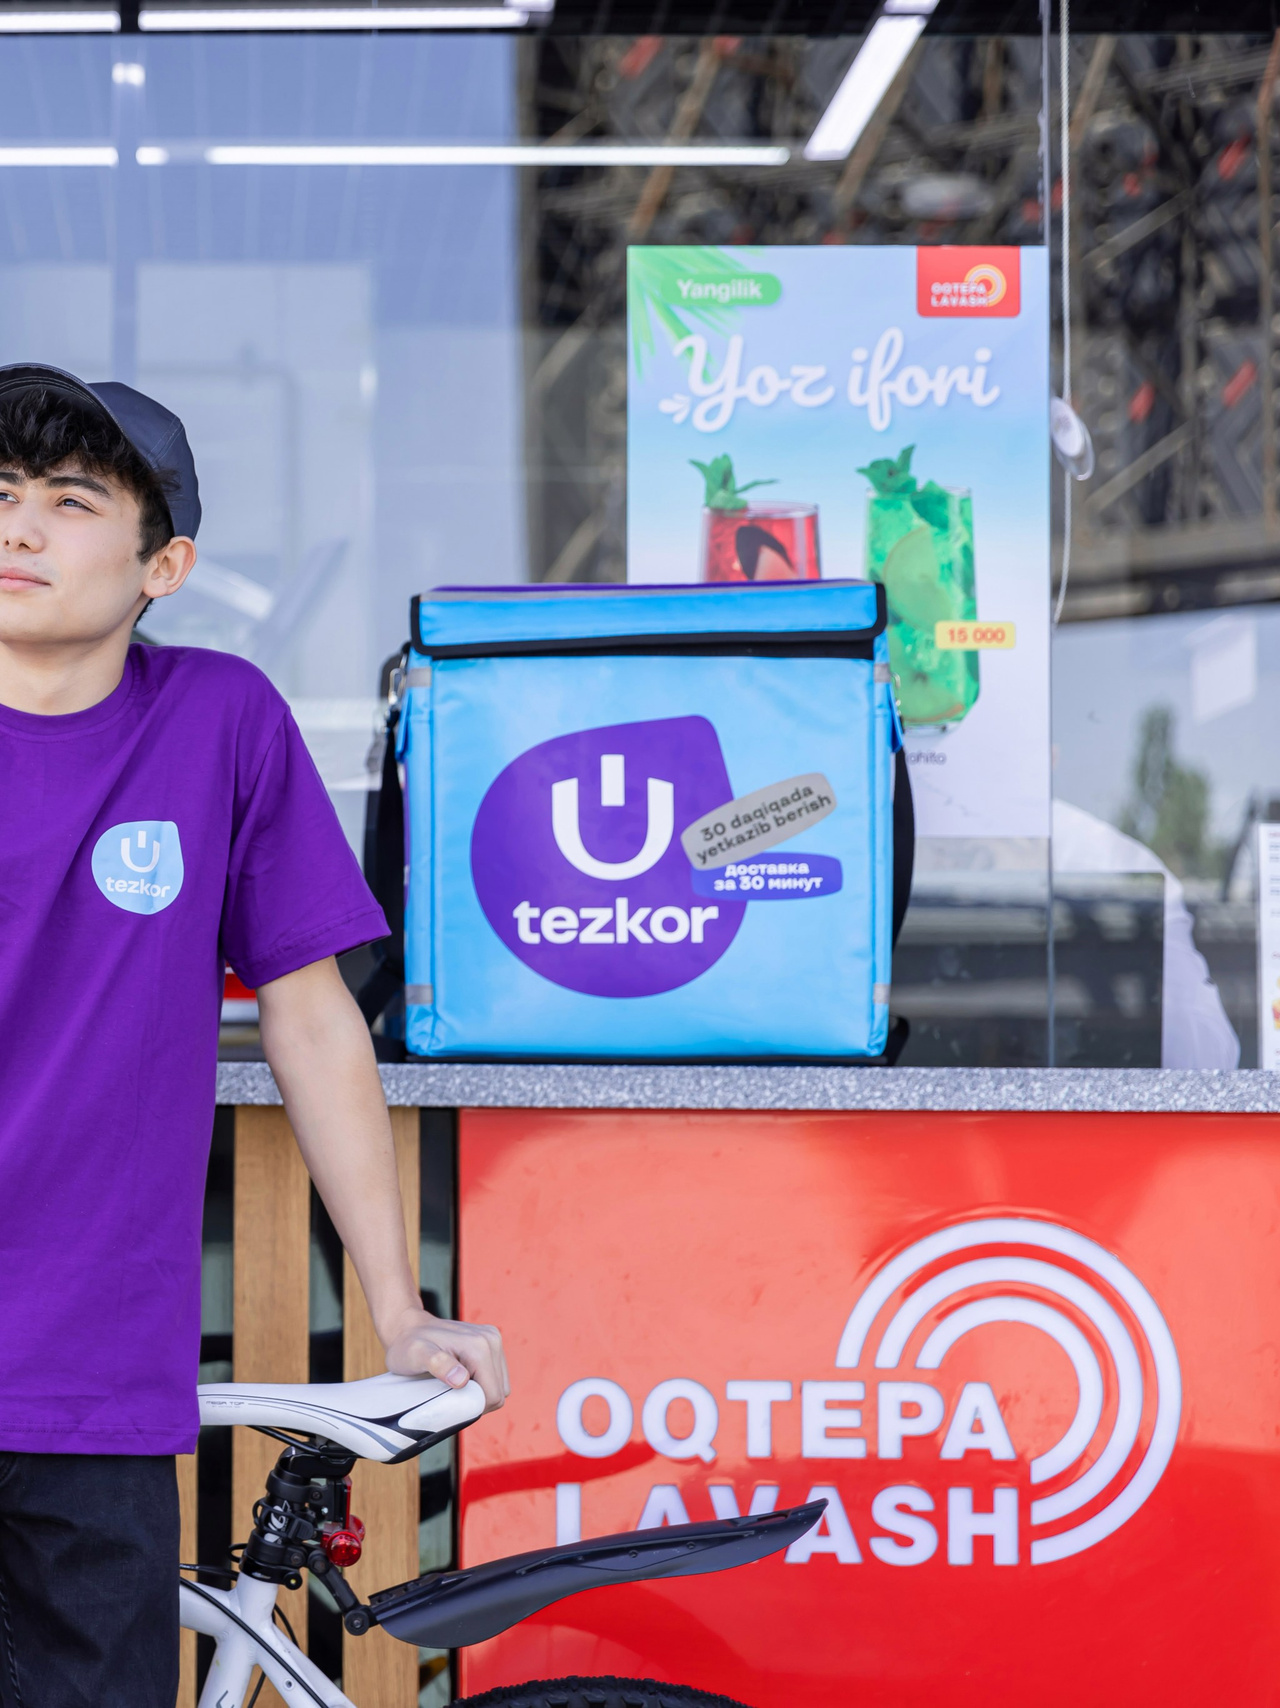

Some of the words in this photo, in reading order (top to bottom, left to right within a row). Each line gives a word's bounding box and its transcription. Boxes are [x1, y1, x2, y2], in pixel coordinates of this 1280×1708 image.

[677, 278, 763, 304] Yangilik
[930, 295, 988, 307] LAVASH
[672, 334, 835, 431] Yoz
[847, 327, 1001, 431] ifori
[948, 627, 968, 643] 15
[972, 627, 1006, 643] 000
[907, 752, 947, 765] ohito
[700, 822, 727, 842] 30
[730, 786, 814, 830] daqiqada
[696, 820, 771, 865] yetkazib
[773, 794, 833, 828] berish
[724, 862, 810, 878] доставка
[105, 876, 171, 898] tezkor
[713, 878, 737, 891] за
[739, 875, 765, 891] 30
[767, 876, 824, 893] минут
[512, 897, 719, 945] tezkor
[556, 1377, 1016, 1462] OQTEPA
